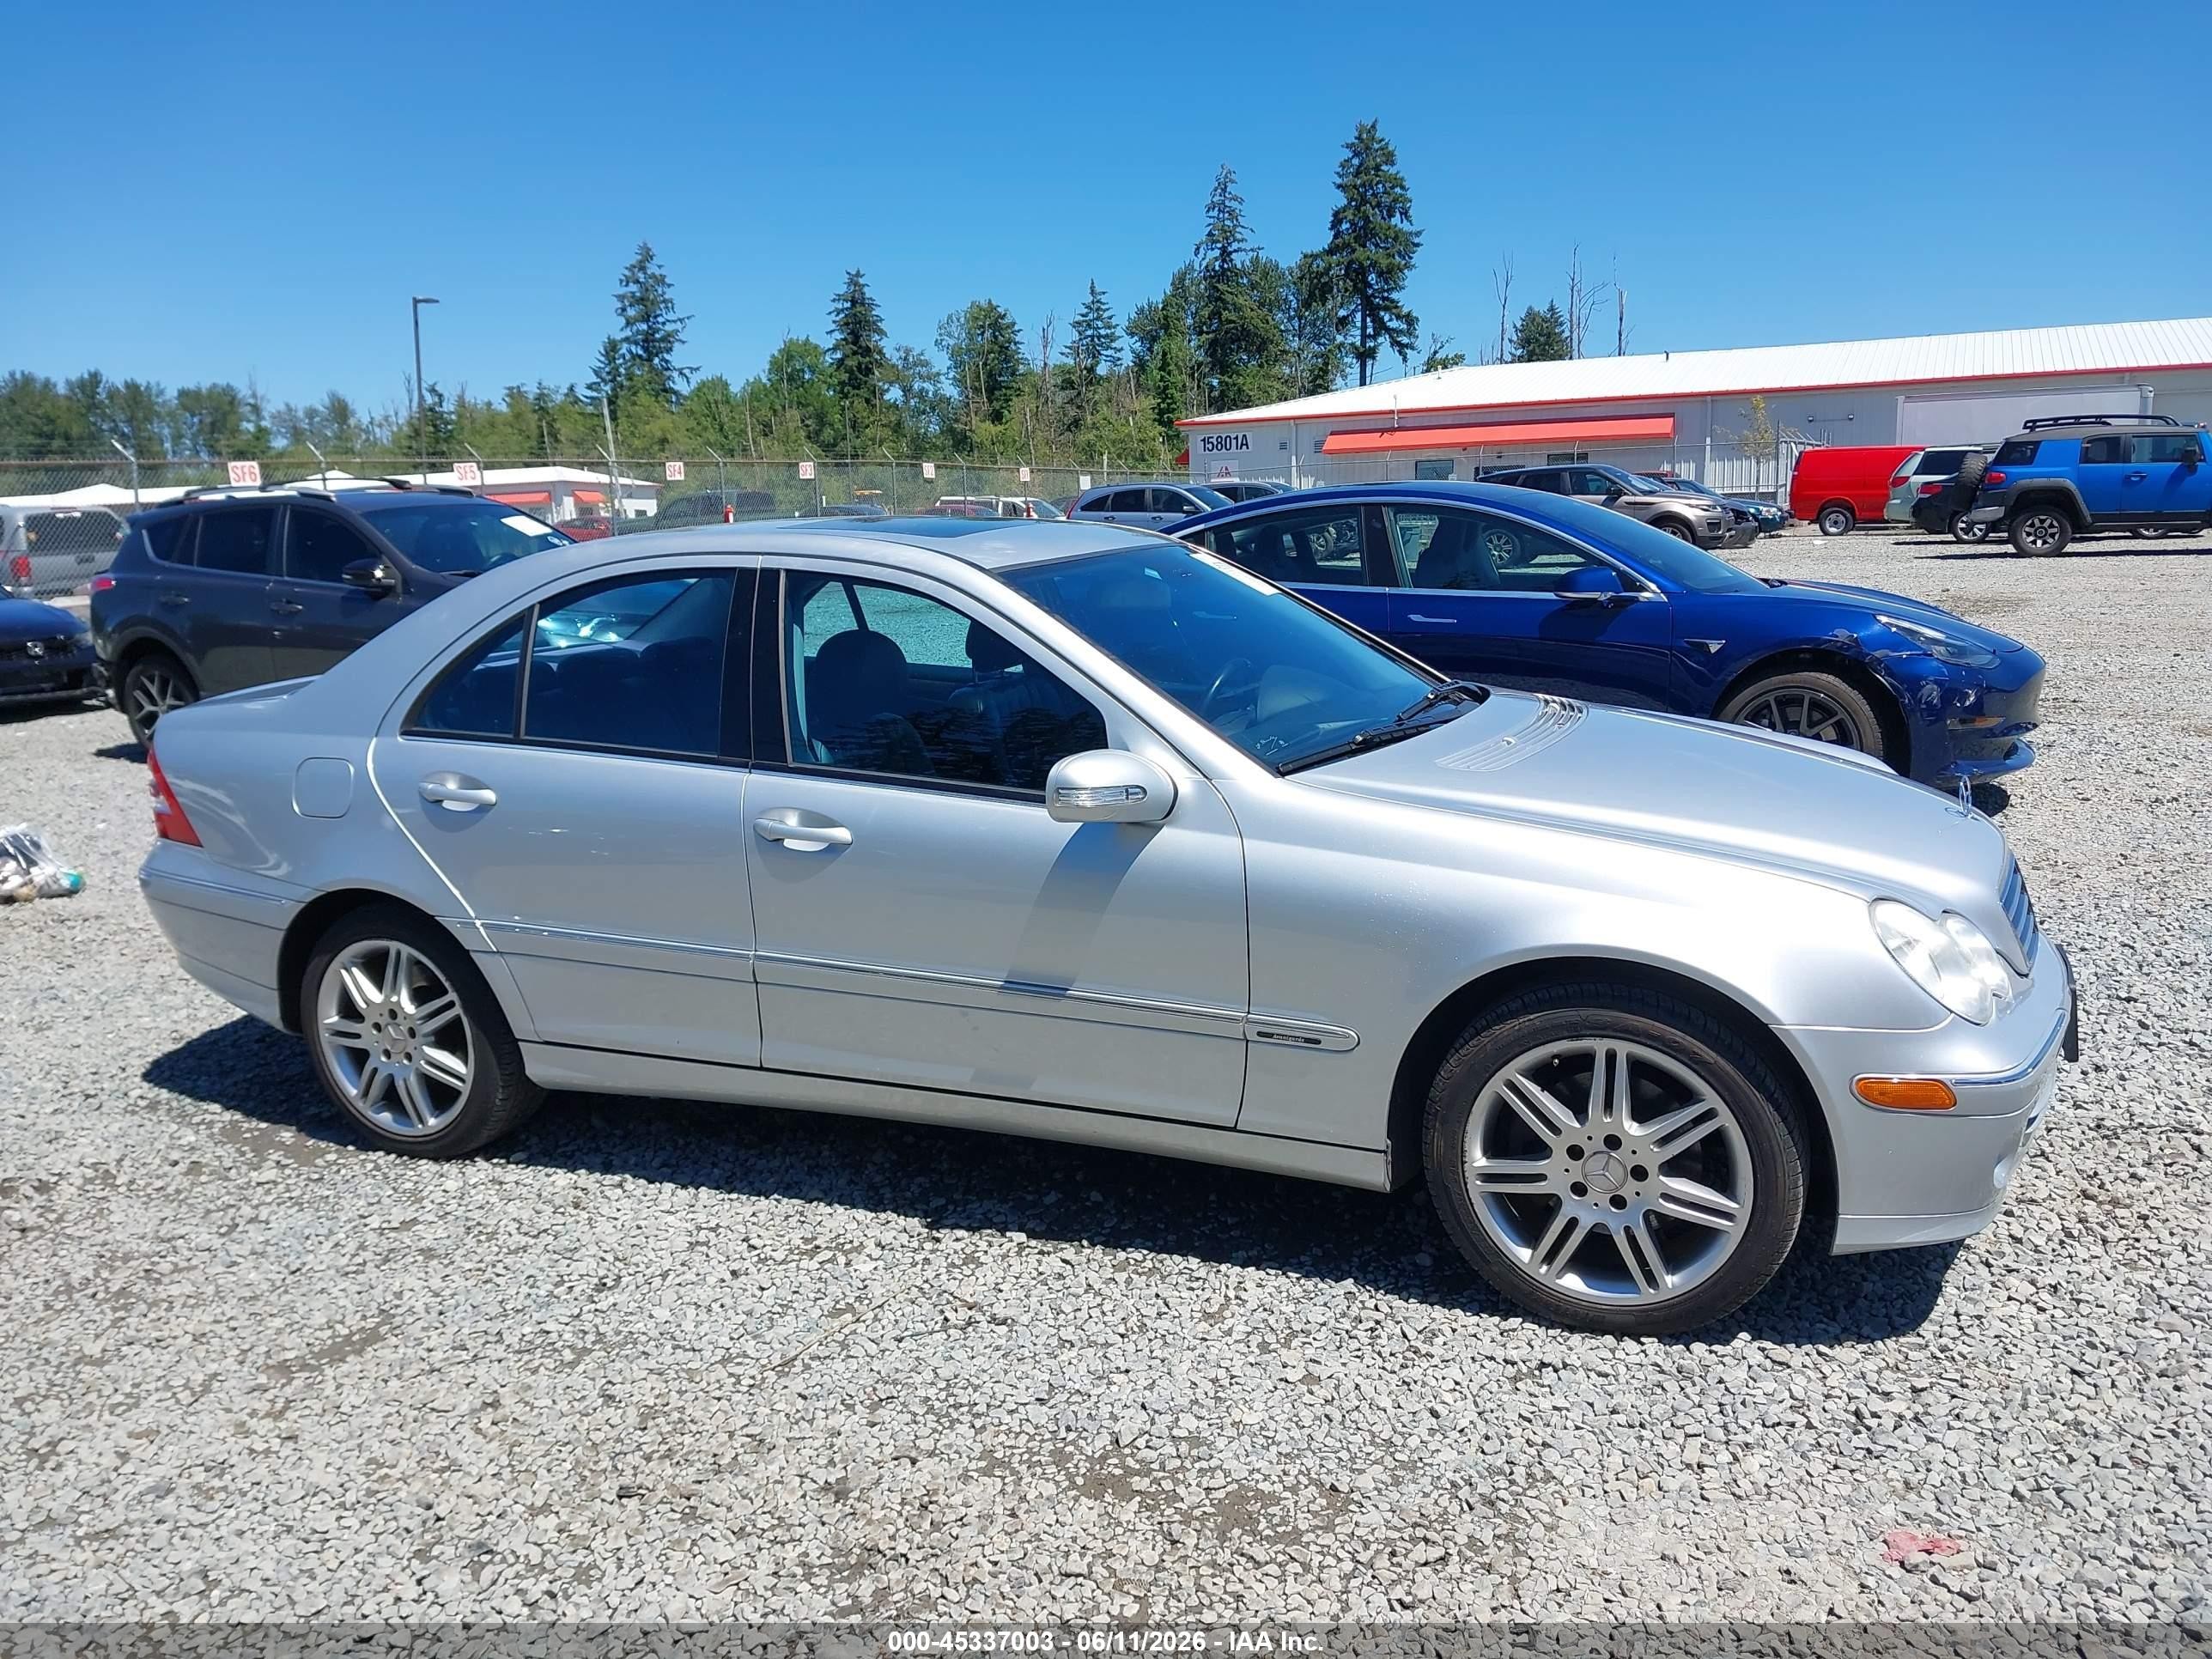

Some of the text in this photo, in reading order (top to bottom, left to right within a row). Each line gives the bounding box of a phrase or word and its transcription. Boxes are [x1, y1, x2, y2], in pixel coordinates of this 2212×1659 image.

[1200, 434, 1249, 453] 15801A
[232, 465, 258, 483] SF6
[456, 465, 476, 481] SF5
[667, 464, 682, 477] SF4
[800, 464, 812, 477] SF3
